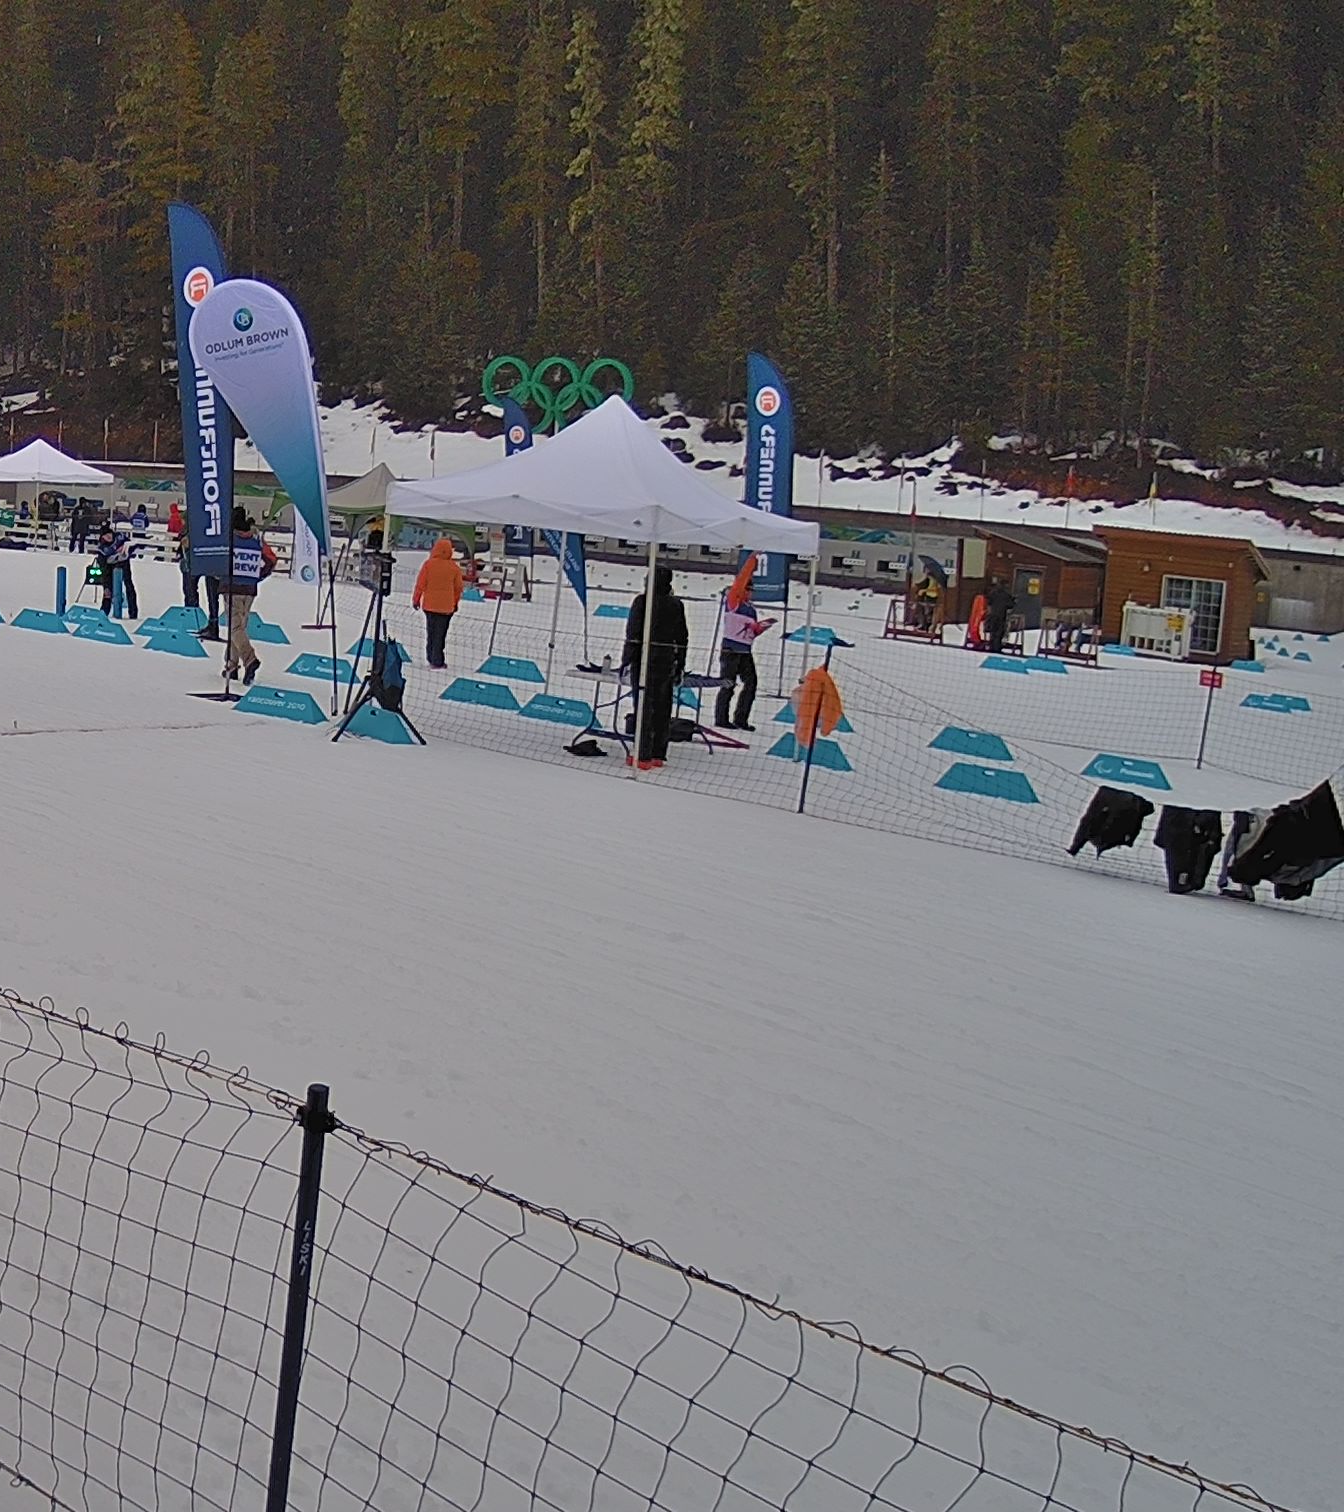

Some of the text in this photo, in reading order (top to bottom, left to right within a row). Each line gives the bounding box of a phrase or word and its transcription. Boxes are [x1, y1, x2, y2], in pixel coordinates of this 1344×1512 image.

[205, 328, 289, 354] ODLUM BROWN
[233, 552, 260, 562] VENT
[234, 562, 259, 572] REW
[298, 1220, 312, 1276] LISKI
